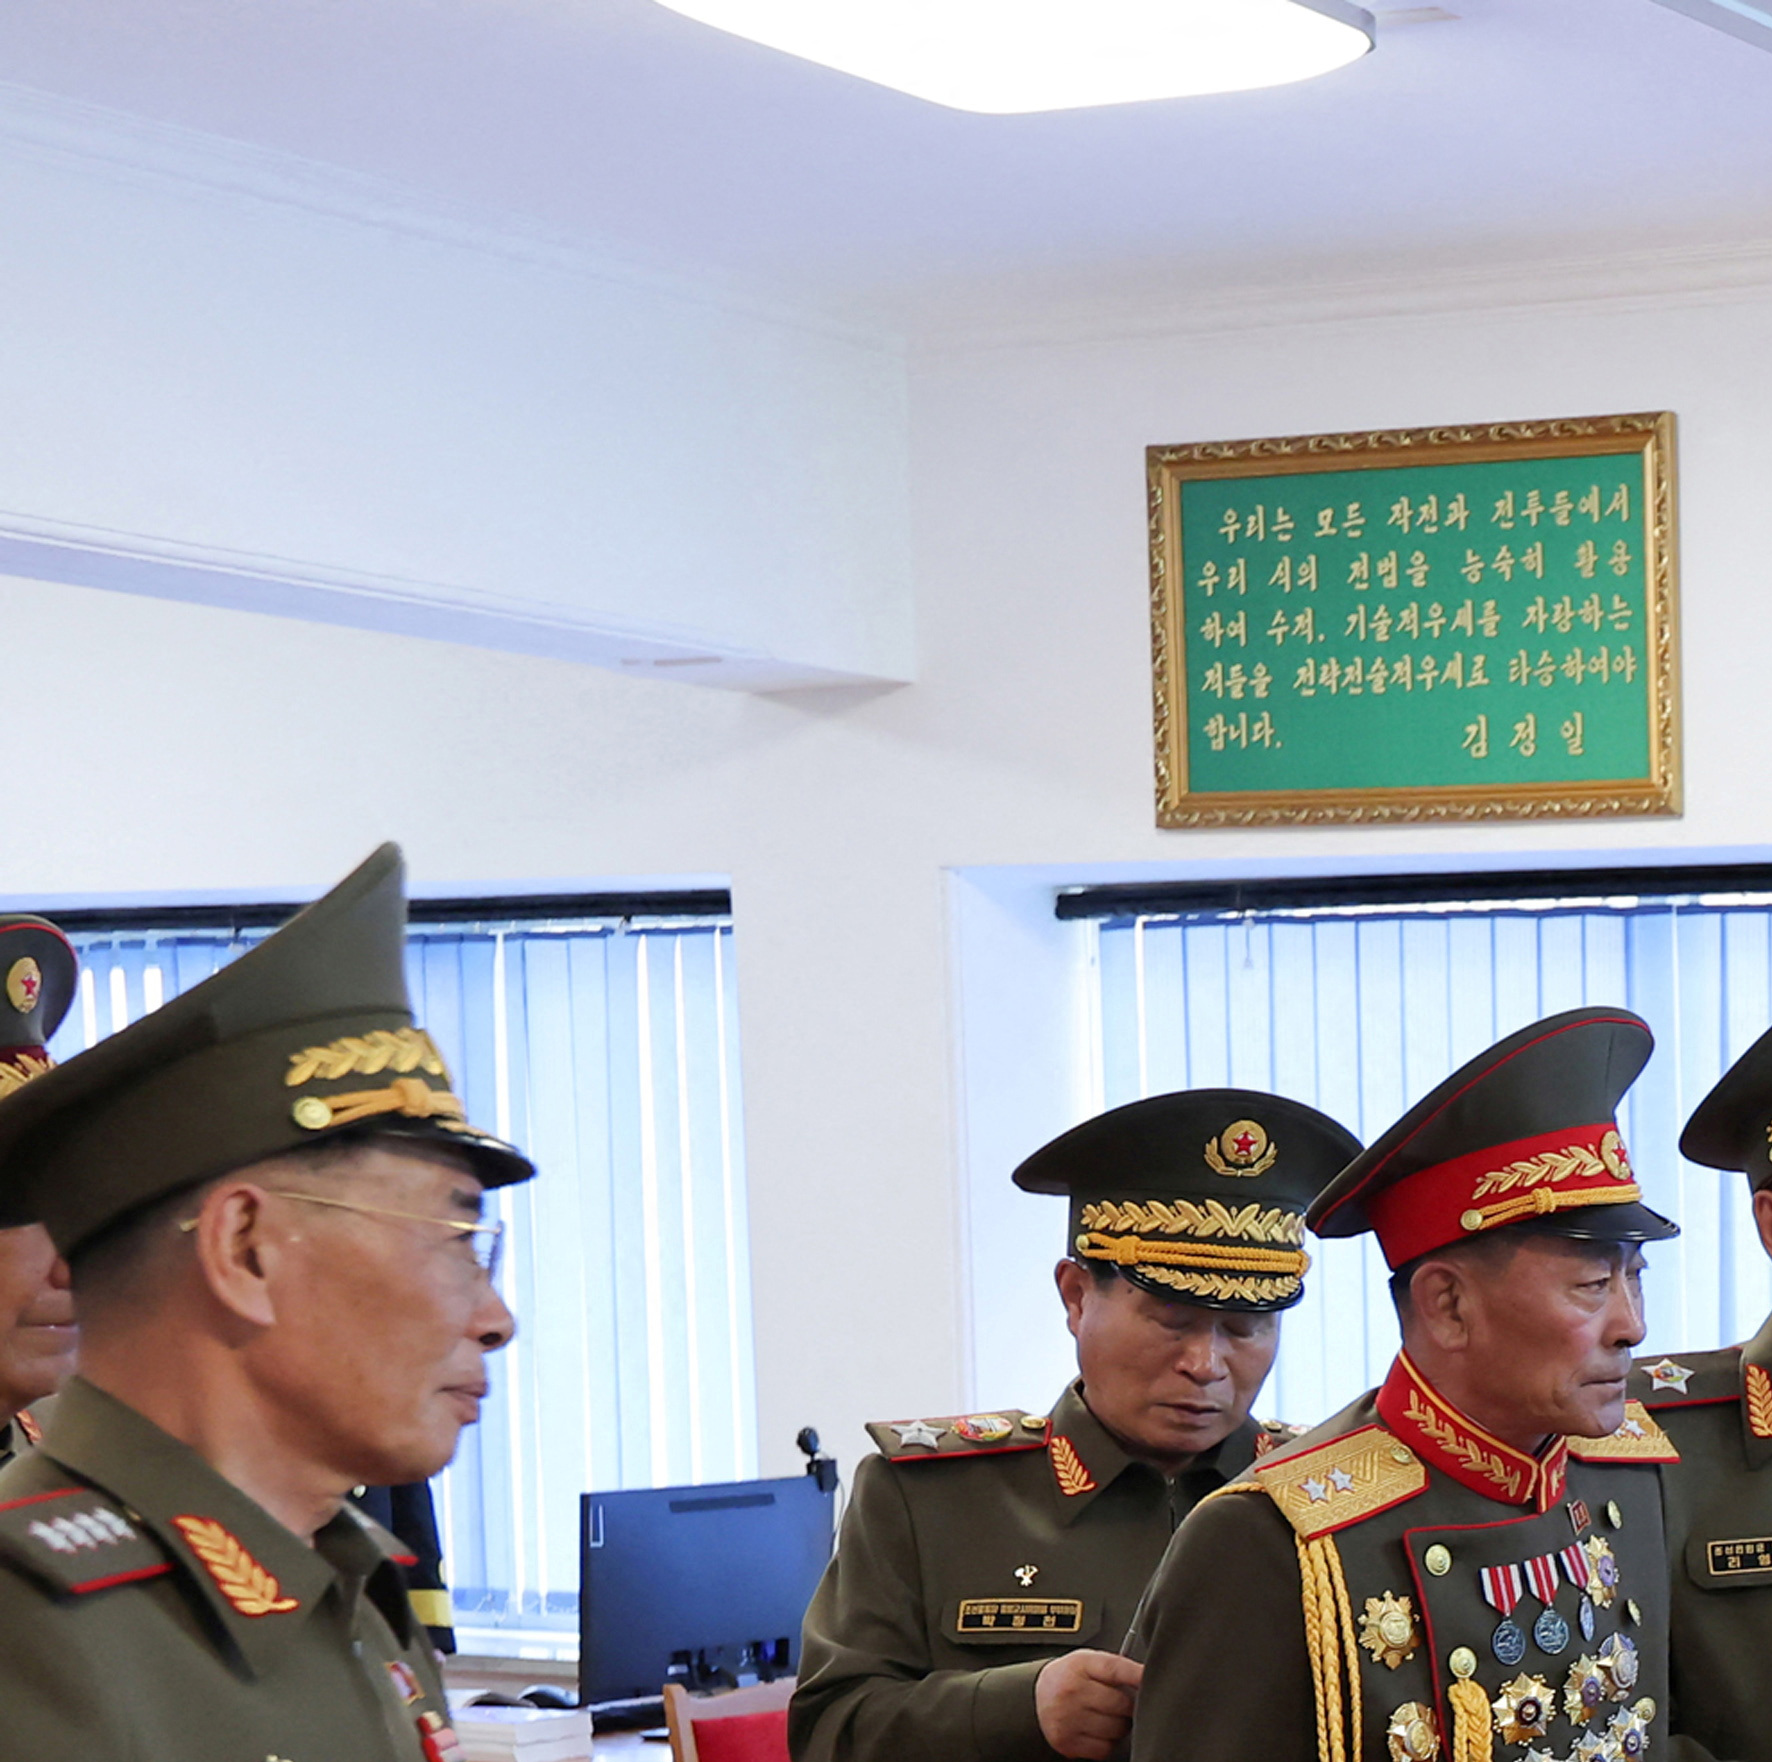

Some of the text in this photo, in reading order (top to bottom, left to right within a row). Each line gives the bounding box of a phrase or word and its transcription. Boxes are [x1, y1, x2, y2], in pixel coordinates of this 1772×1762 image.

[1218, 483, 1630, 544] 우리는 모든 작전과 전투들에서
[1197, 557, 1247, 597] 우리
[1268, 554, 1318, 593] 식의
[1346, 550, 1431, 591] 전법을
[1460, 541, 1544, 585] 능숙히
[1199, 610, 1247, 648] 하여
[1344, 598, 1502, 643] 기술적우세를
[1521, 592, 1634, 634] 자랑하는
[1201, 644, 1639, 700] 적들을 전략전술적우세로 타승하여야
[1203, 710, 1282, 751] 합니다.
